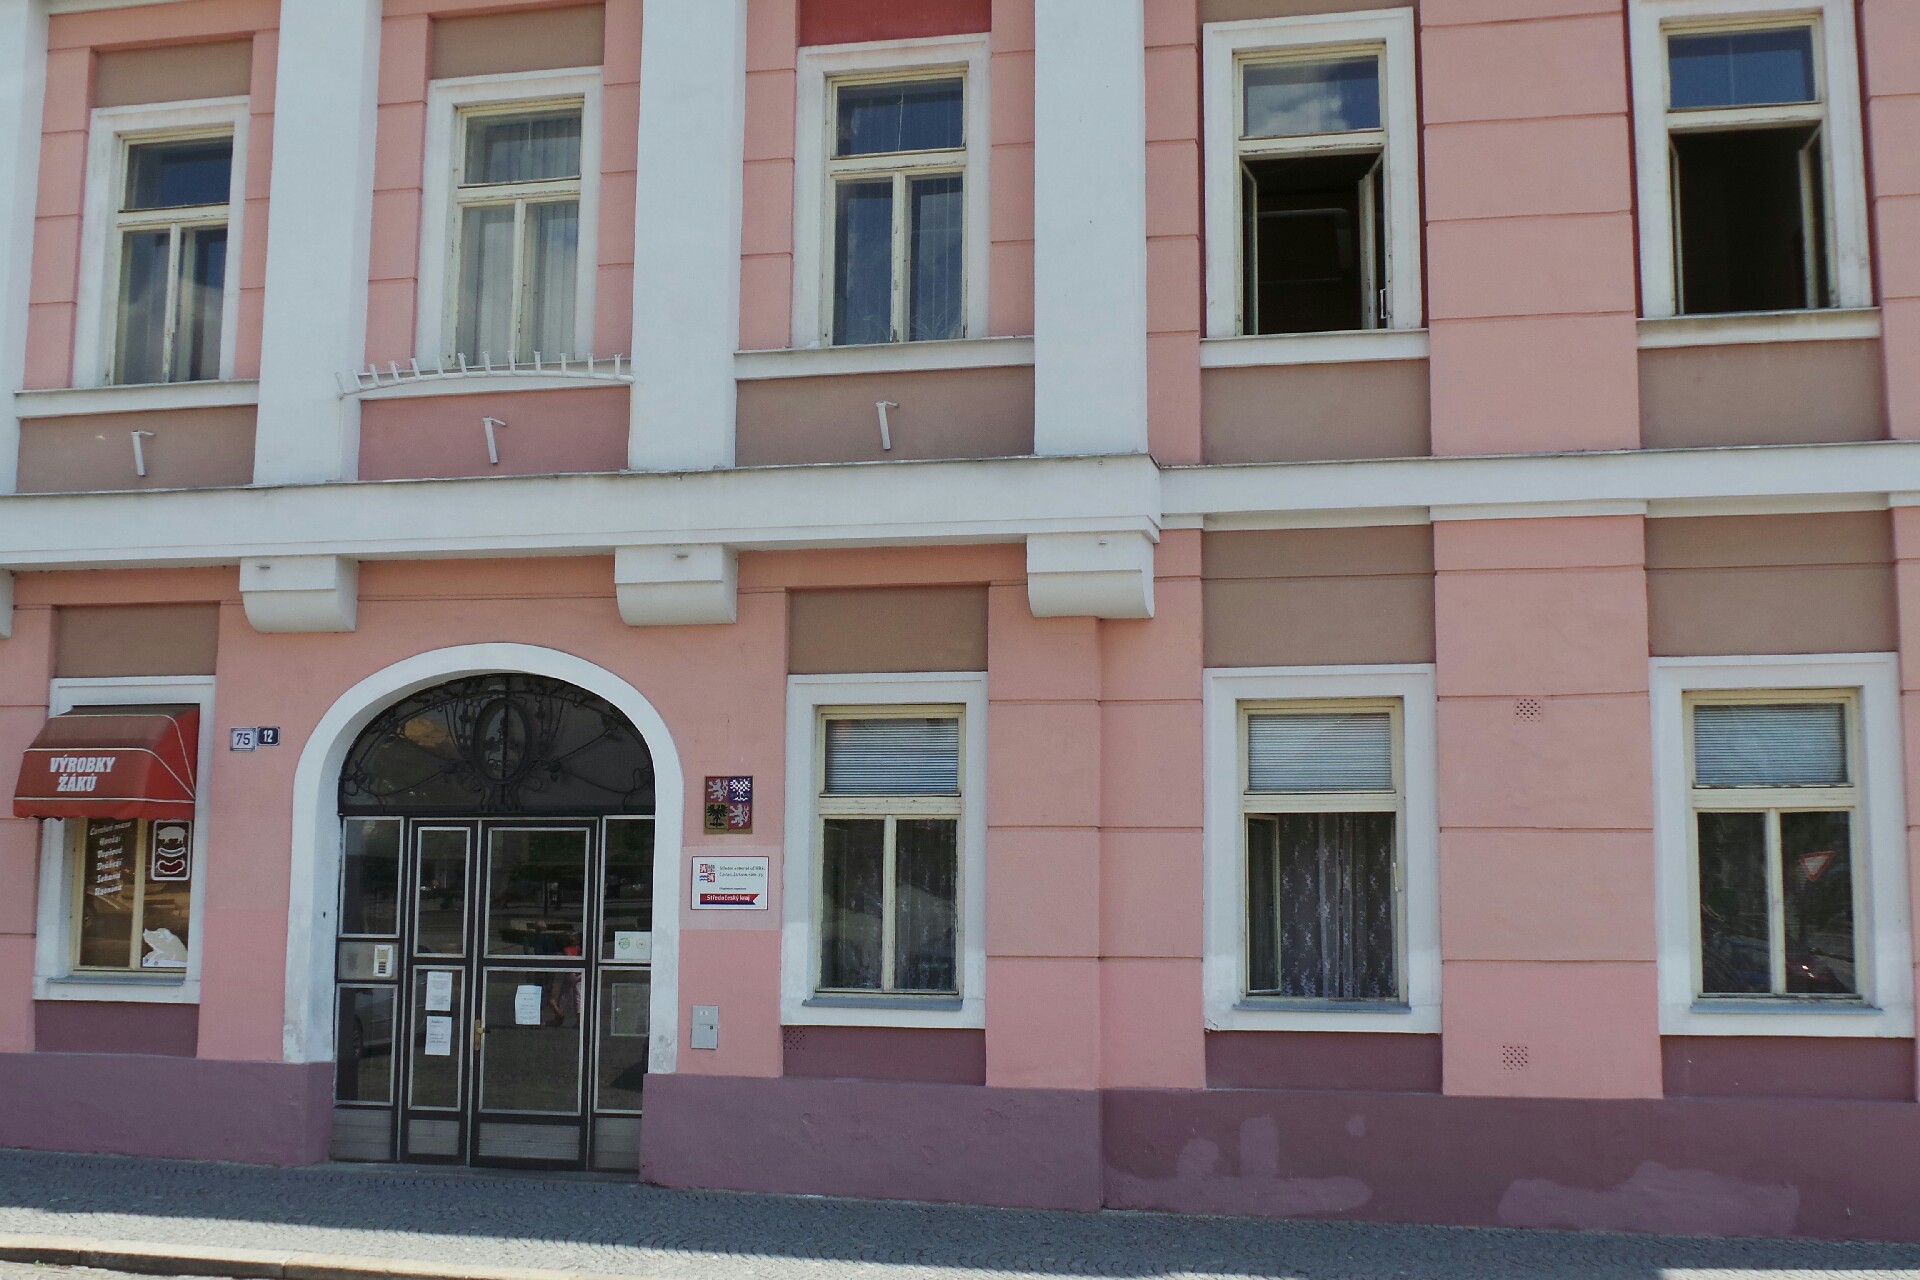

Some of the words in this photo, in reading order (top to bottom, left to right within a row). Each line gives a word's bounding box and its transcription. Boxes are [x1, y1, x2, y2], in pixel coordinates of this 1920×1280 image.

[236, 733, 250, 745] 75
[263, 730, 273, 742] 12
[50, 754, 116, 772] VÝROBKY
